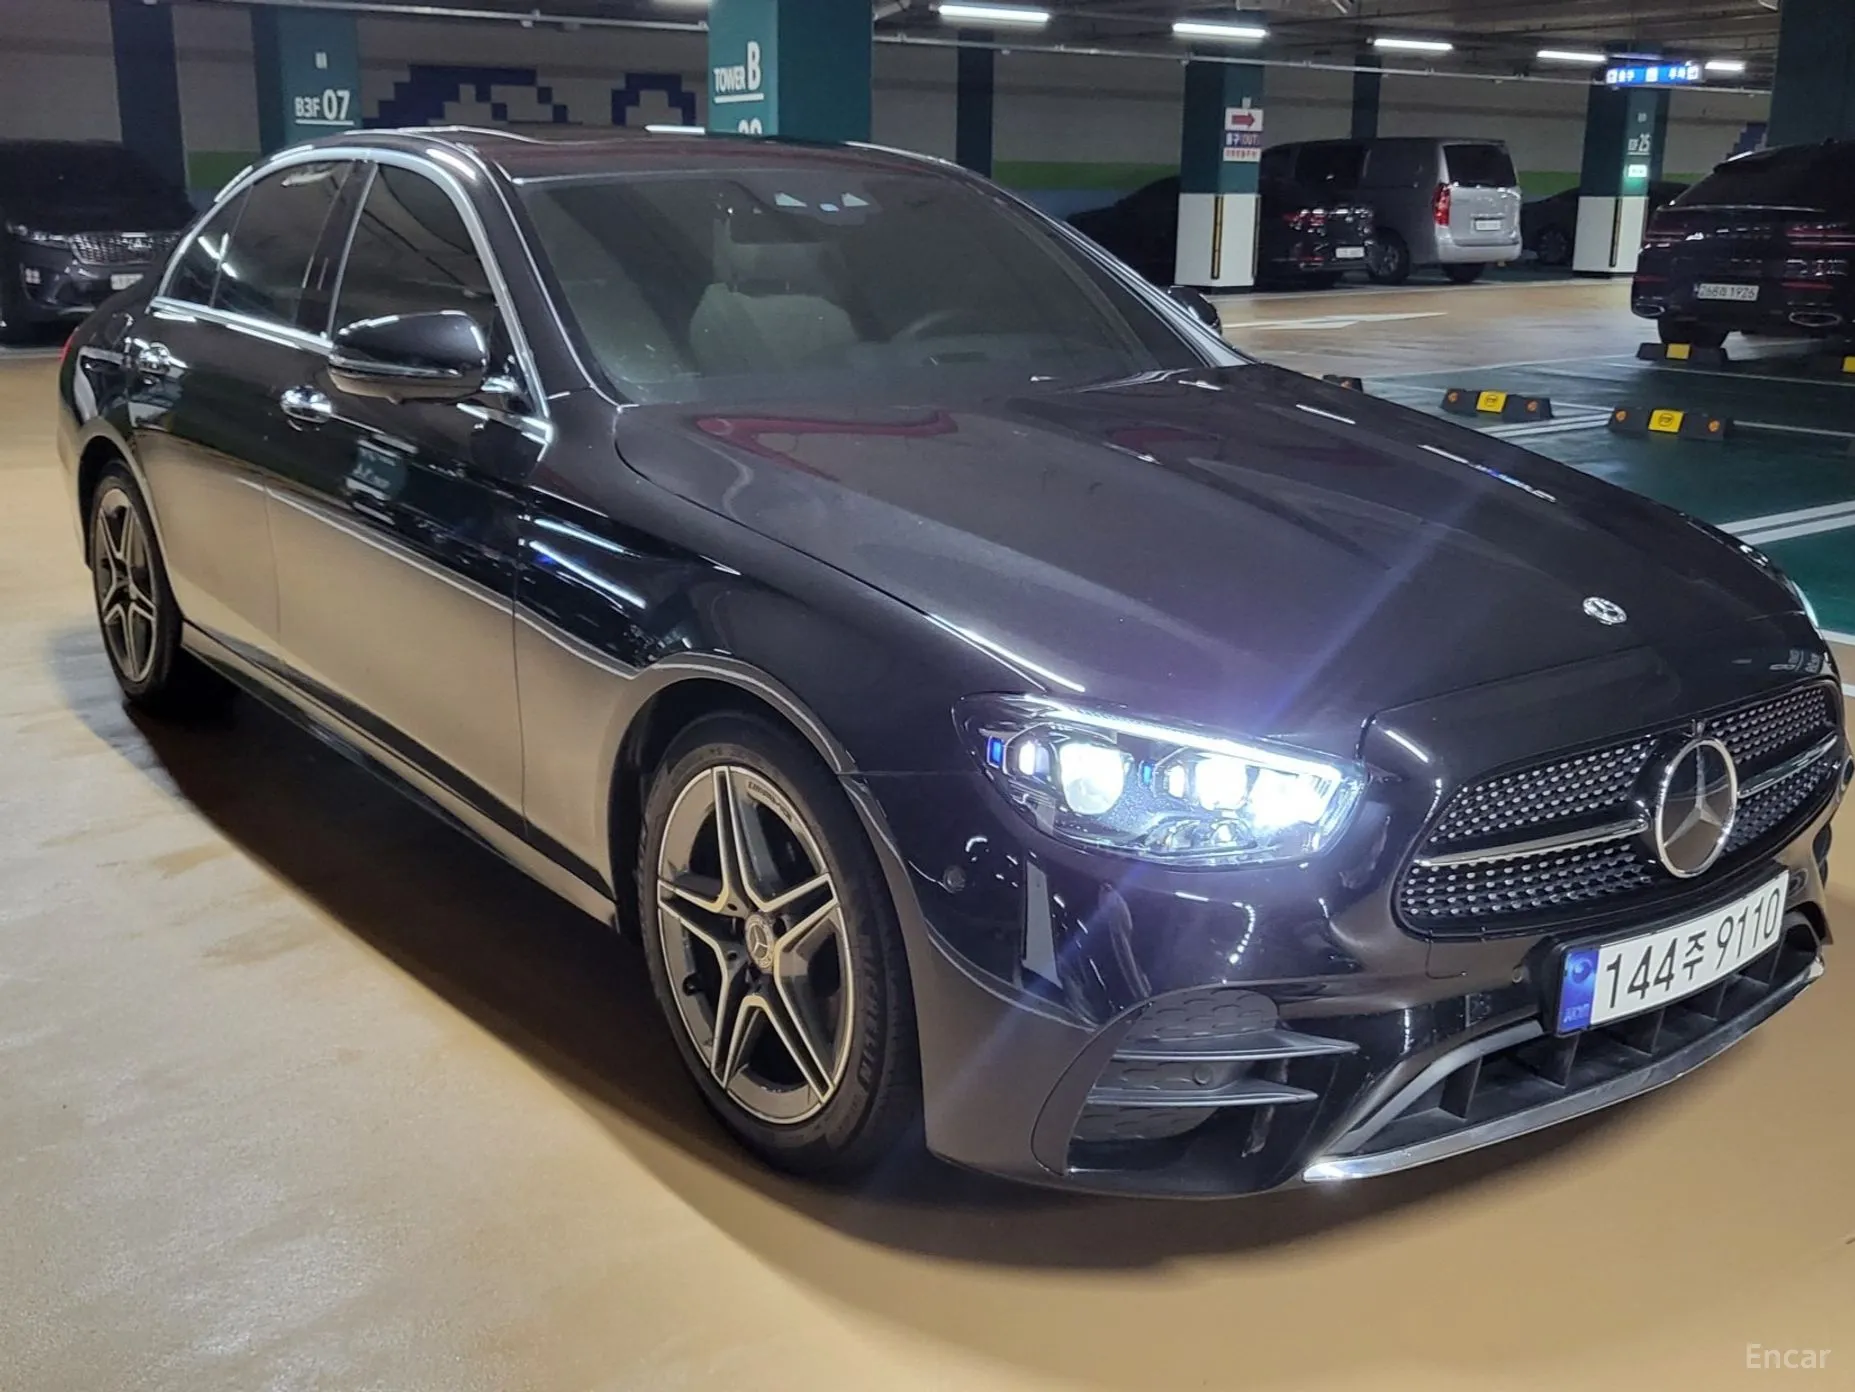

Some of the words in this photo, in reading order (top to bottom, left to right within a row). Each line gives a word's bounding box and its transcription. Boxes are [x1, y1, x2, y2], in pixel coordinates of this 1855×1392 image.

[713, 65, 746, 93] TOWER
[747, 41, 761, 91] B
[295, 96, 320, 117] B3F
[322, 88, 350, 121] 07
[1606, 930, 1707, 1009] 144주
[1716, 887, 1781, 970] 9110
